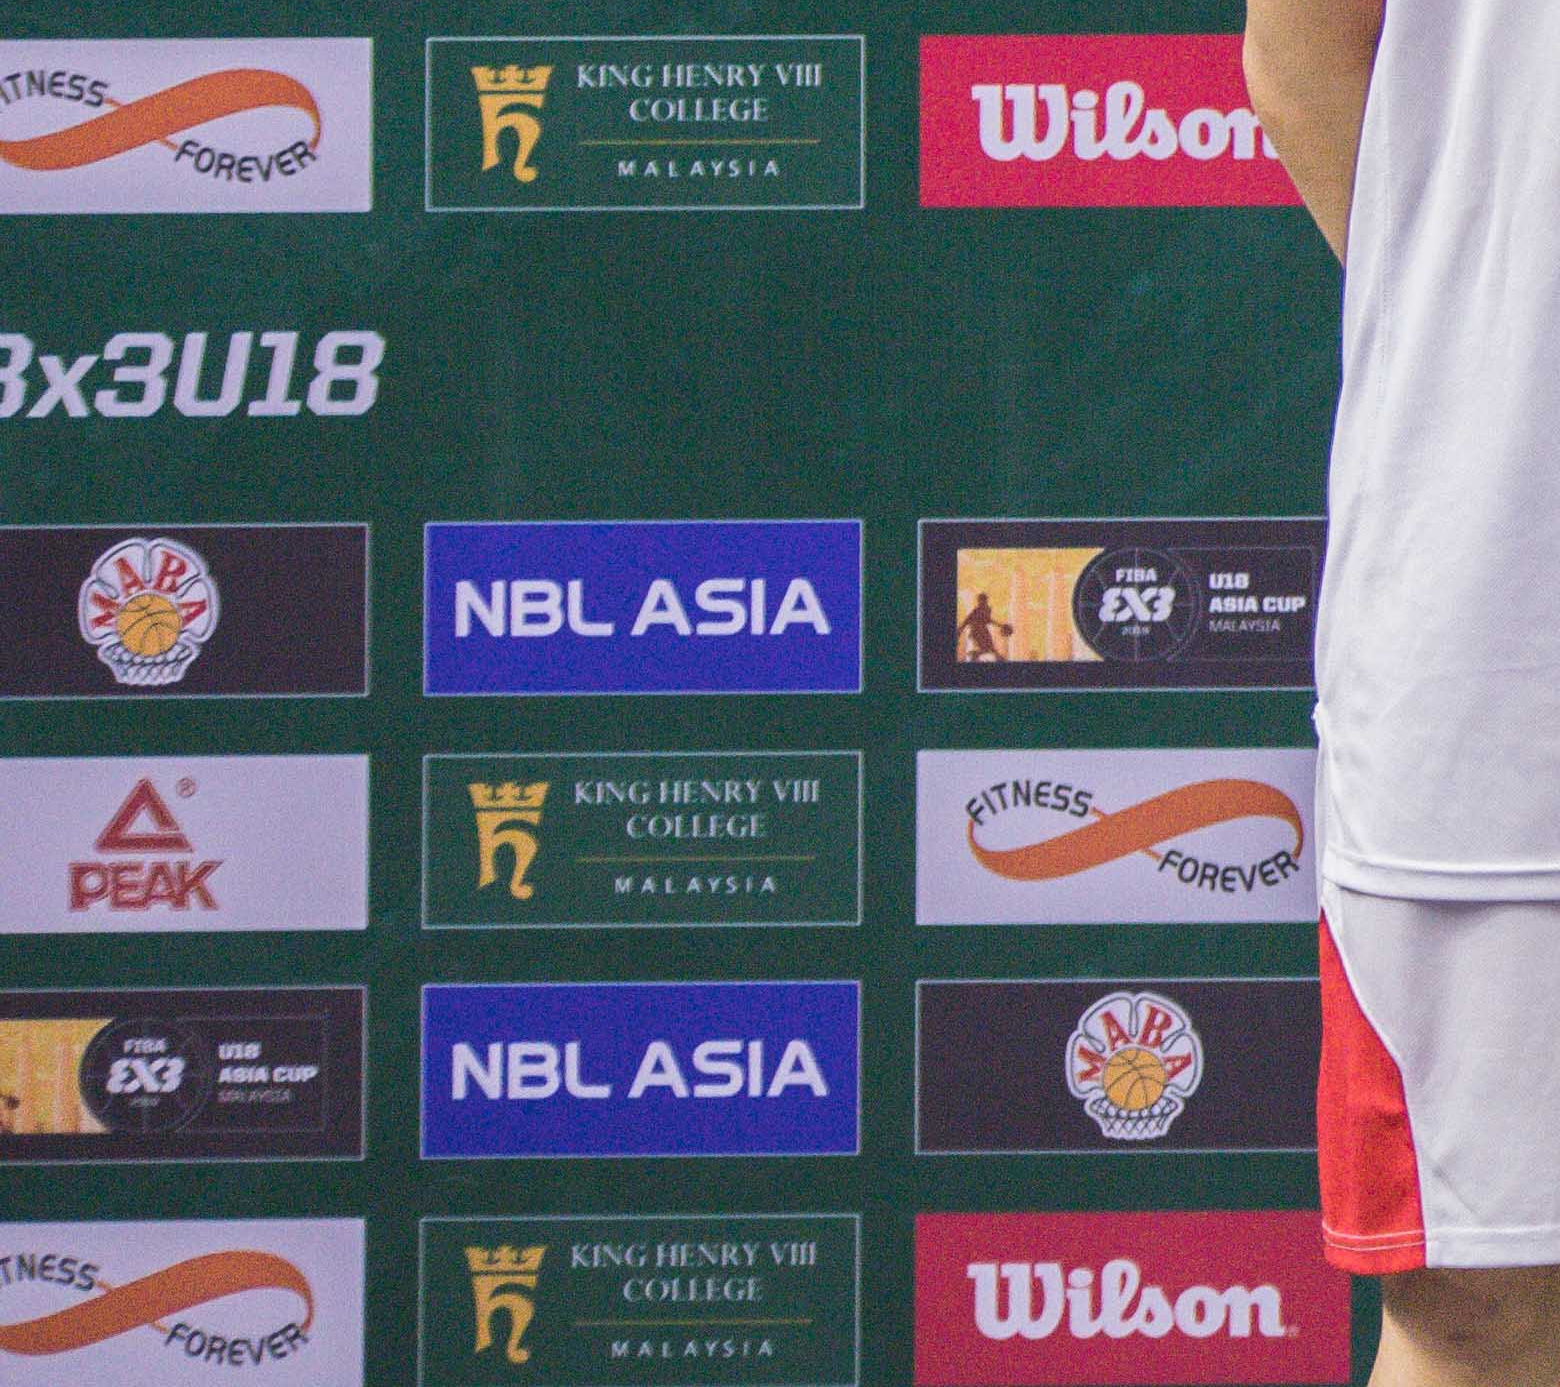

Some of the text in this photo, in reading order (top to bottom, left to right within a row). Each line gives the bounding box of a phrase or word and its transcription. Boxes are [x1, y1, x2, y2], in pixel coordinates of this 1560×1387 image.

[174, 138, 317, 183] FOREVER
[92, 552, 207, 631] MABA
[456, 579, 830, 637] NBL ASIA
[964, 780, 1095, 827] FITNESS
[70, 861, 222, 910] PEAK
[1157, 846, 1304, 894] FOREVER
[453, 1040, 827, 1099] NBL ASIA
[1079, 1007, 1192, 1086] MABA
[165, 1321, 308, 1367] FOREVER
